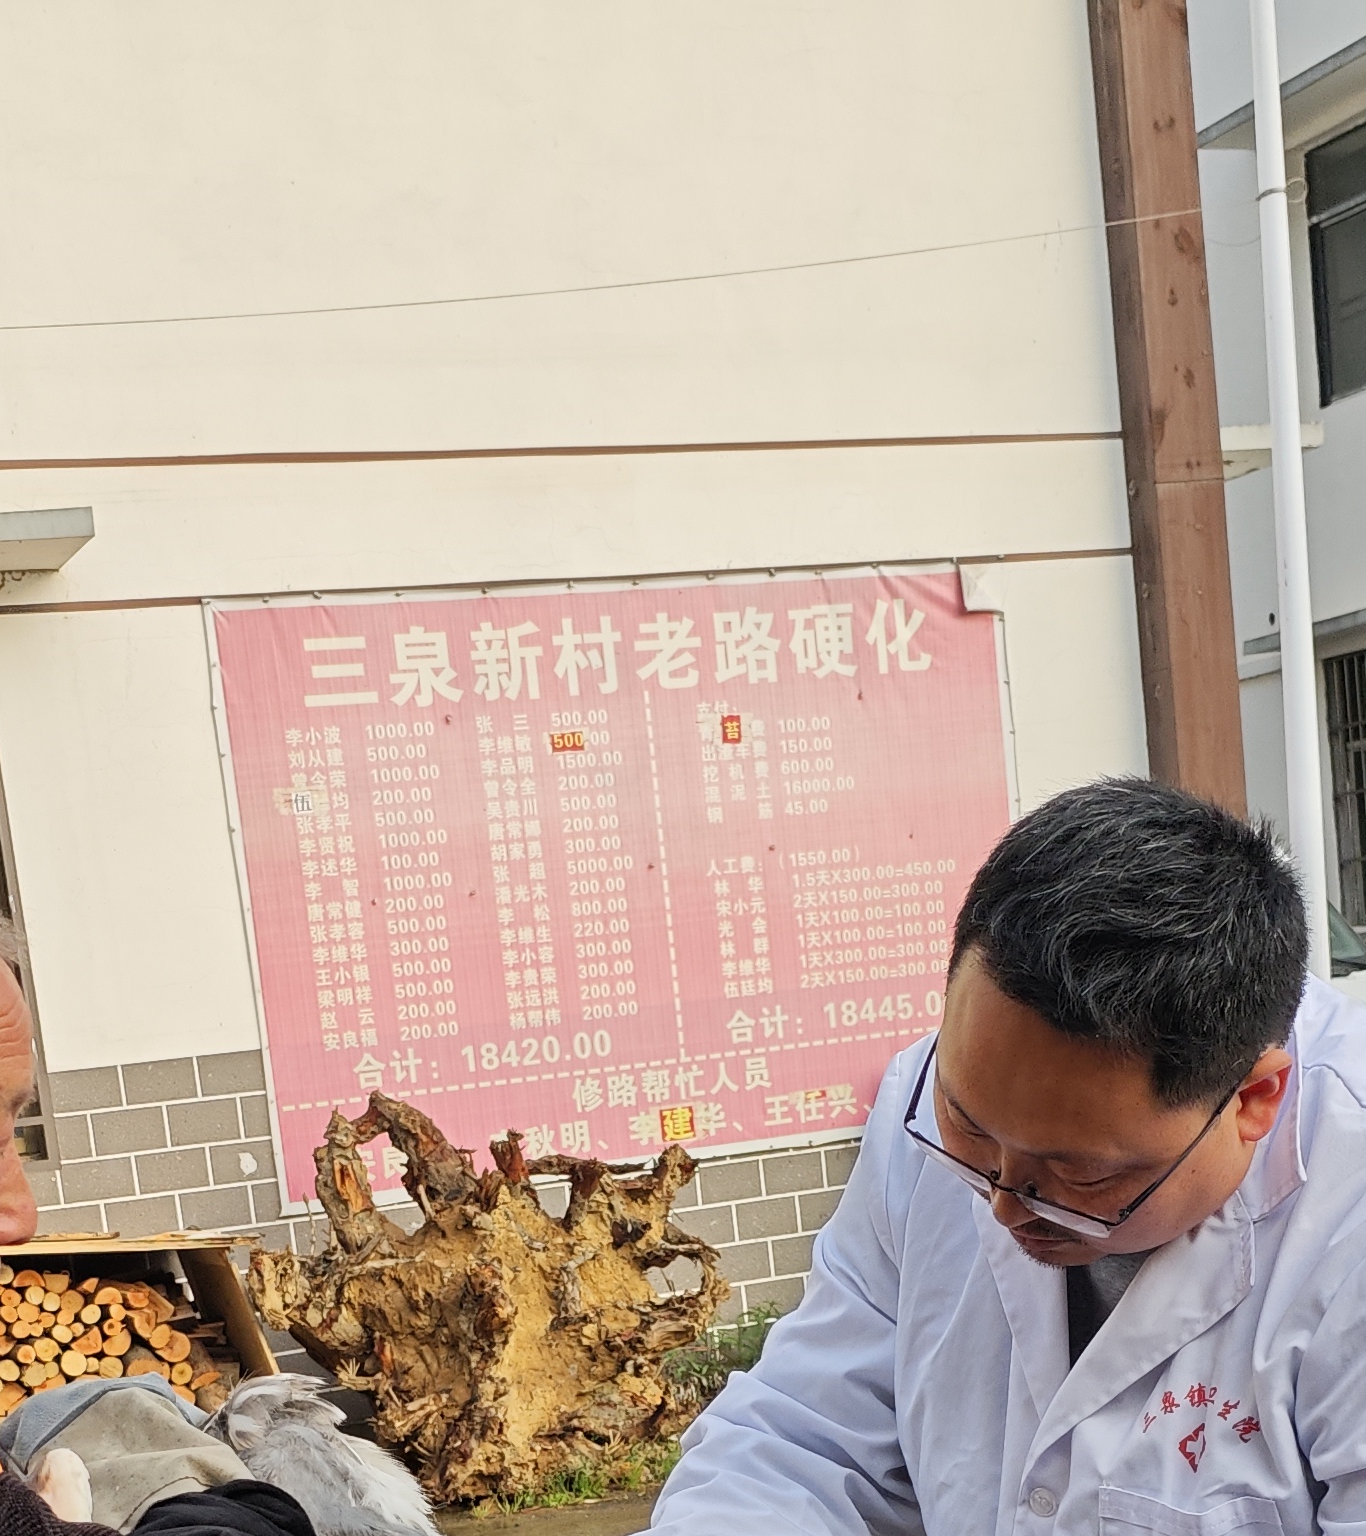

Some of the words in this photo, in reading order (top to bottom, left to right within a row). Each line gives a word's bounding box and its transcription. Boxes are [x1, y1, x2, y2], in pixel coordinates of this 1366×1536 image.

[302, 598, 933, 708] 三泉新村老路硬化
[551, 709, 608, 727] 500.00
[778, 716, 831, 733] 100.00
[285, 725, 341, 747] 李小波
[365, 721, 434, 740] 1000.00
[780, 737, 832, 754] 150.00
[288, 748, 344, 769] 刘从建
[368, 744, 427, 762] 500.00
[482, 756, 533, 777] 李品明
[556, 751, 623, 769] 1500.00
[781, 757, 834, 775] 600.00
[370, 765, 440, 784] 1000.00
[559, 773, 615, 791] 200.00
[784, 776, 855, 795] 16000.00
[293, 792, 349, 813] 伍均
[372, 787, 432, 806] 200.00
[561, 794, 617, 812] 500.00
[785, 799, 828, 815] 45.00
[375, 809, 434, 827] 500.00
[563, 815, 619, 833] 200.00
[378, 829, 447, 848] 1000.00
[565, 836, 621, 854] 300.00
[381, 852, 440, 870] 100.00
[567, 856, 633, 875] 5000.00
[384, 872, 452, 891] 1000.00
[569, 877, 625, 896] 200.00
[385, 895, 444, 913] 200.00
[571, 897, 628, 917] 800.00
[387, 916, 447, 935] 500.00
[574, 918, 630, 938] 220.00
[390, 937, 449, 956] 300.00
[502, 946, 555, 968] 李小容
[576, 939, 632, 958] 300.00
[316, 965, 370, 987] 王小银
[392, 958, 451, 977] 500.00
[578, 960, 634, 979] 300.00
[395, 979, 454, 999] 500.00
[580, 980, 636, 1000] 200.00
[398, 1000, 457, 1020] 200.00
[583, 1001, 638, 1021] 200.00
[323, 1029, 378, 1051] 安良福
[400, 1021, 459, 1042] 200.00
[461, 1029, 612, 1074] 18420.00
[572, 1057, 773, 1113] 修路帮忙人员
